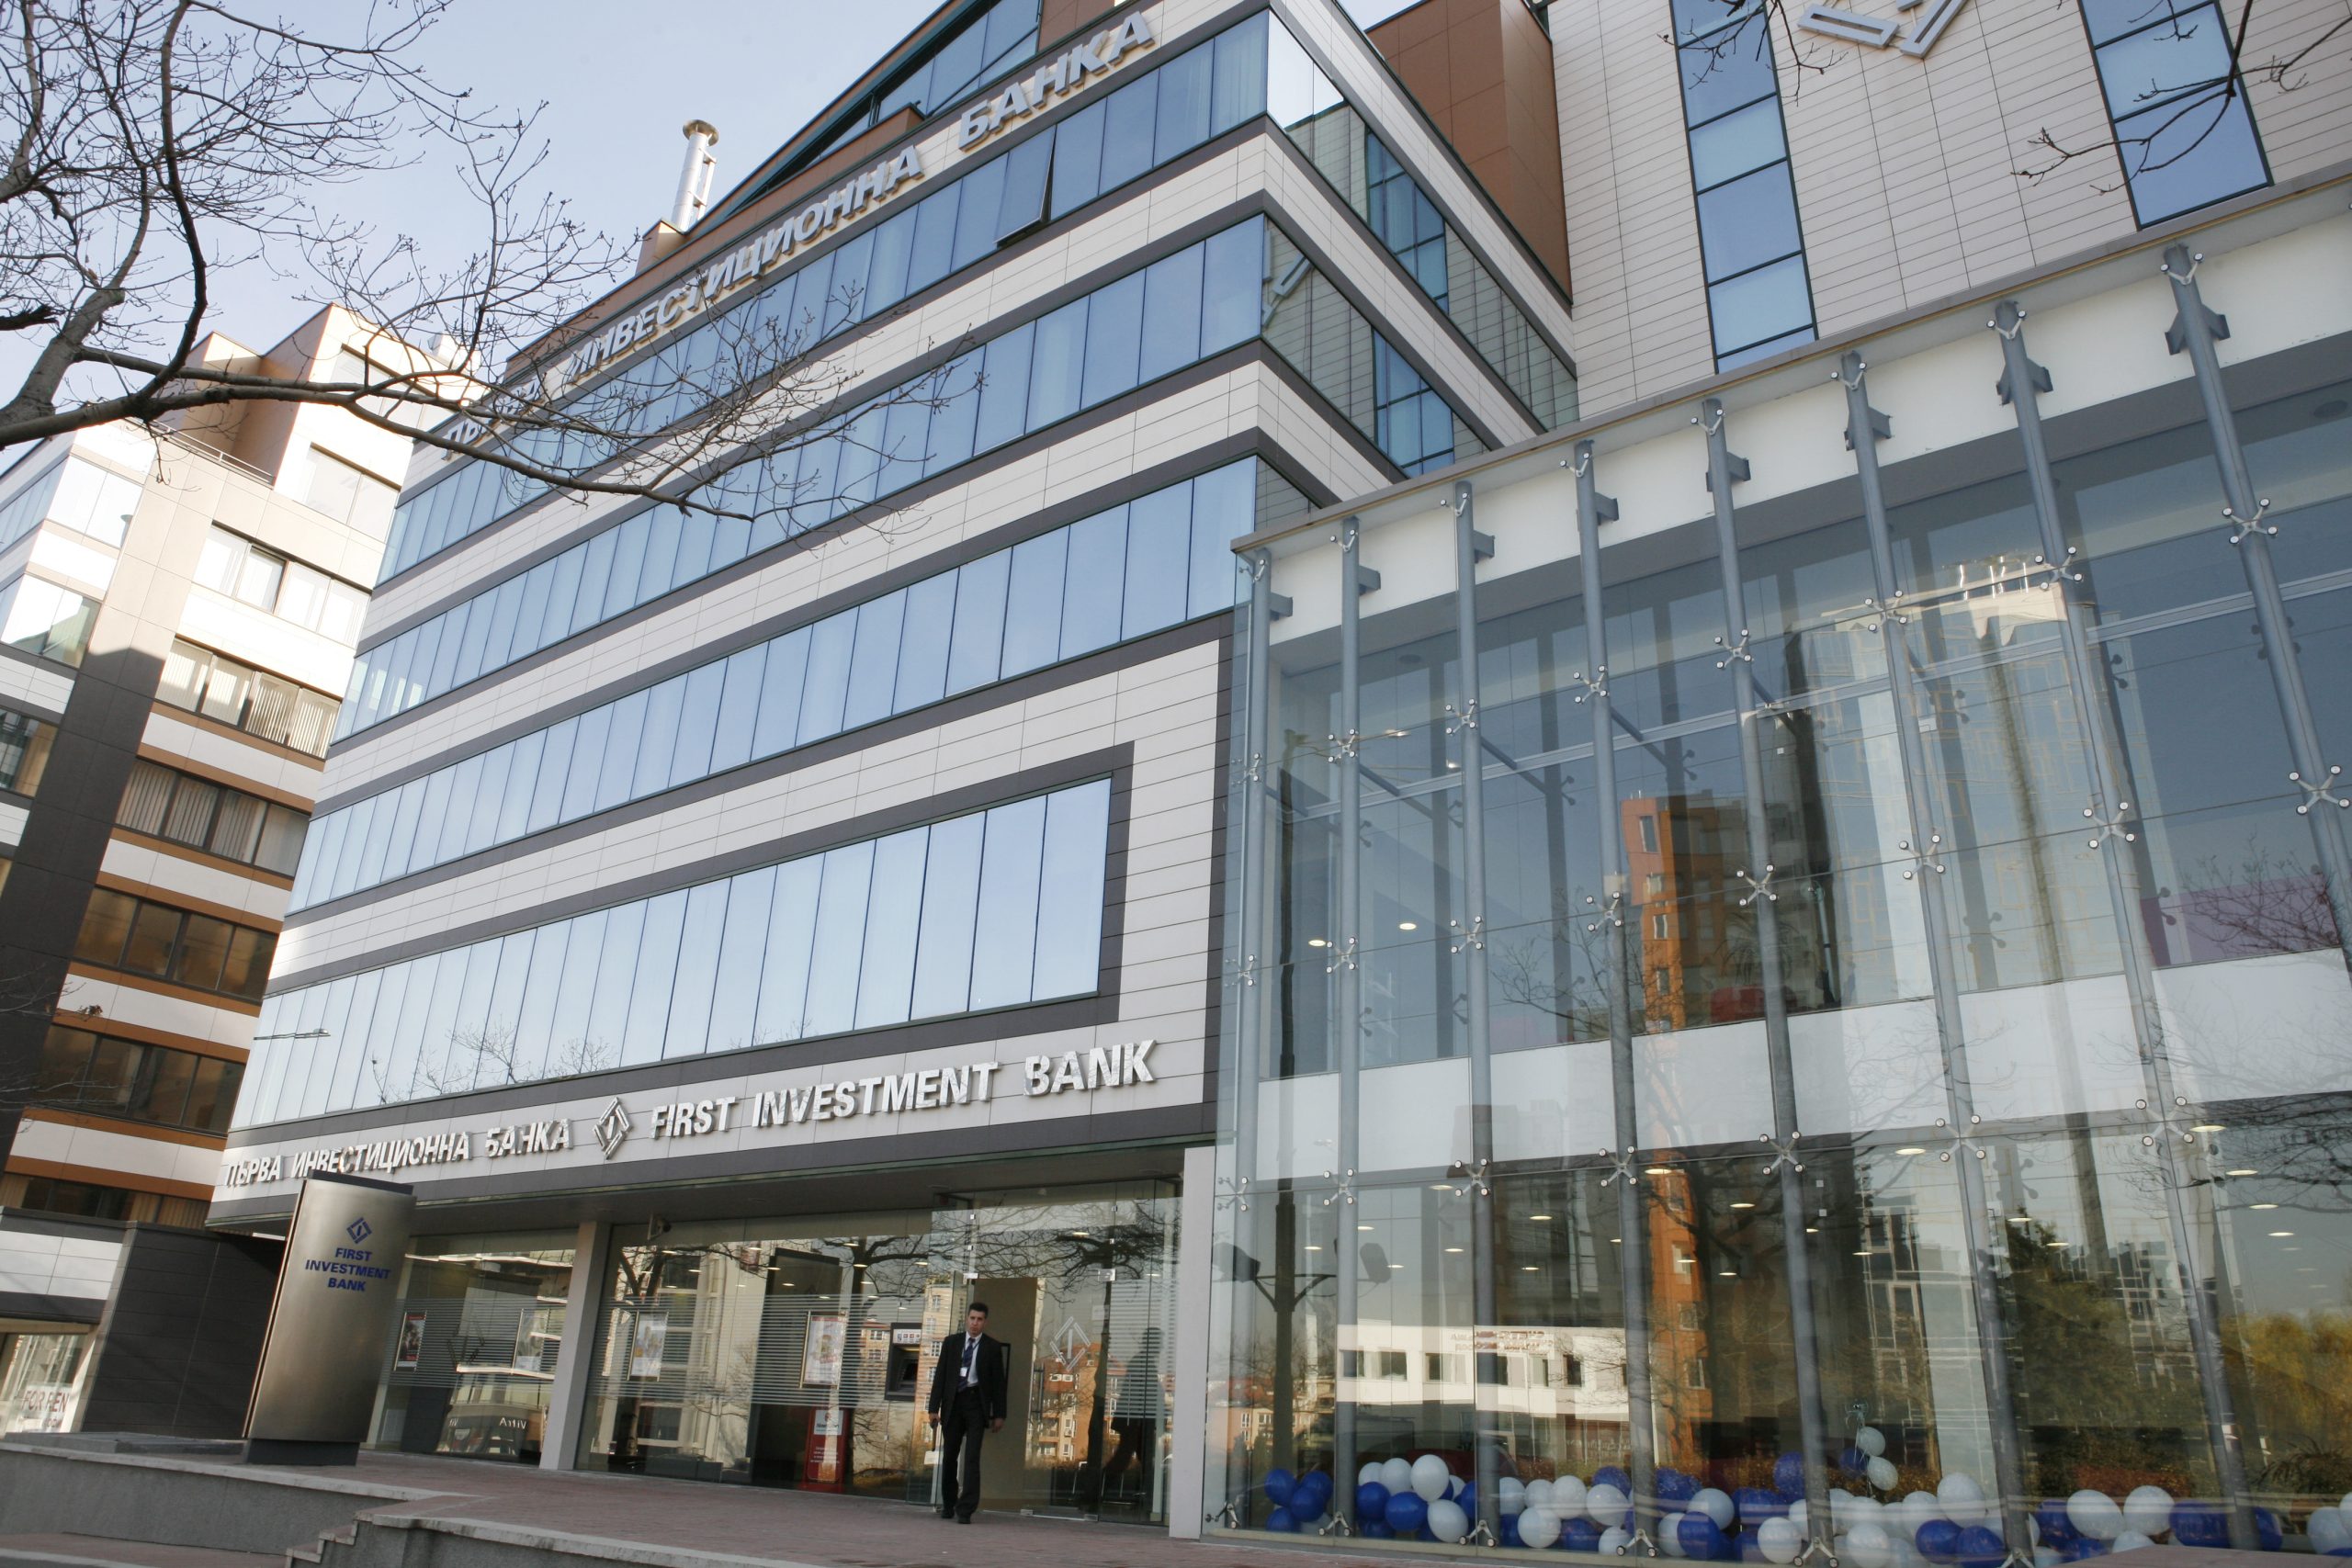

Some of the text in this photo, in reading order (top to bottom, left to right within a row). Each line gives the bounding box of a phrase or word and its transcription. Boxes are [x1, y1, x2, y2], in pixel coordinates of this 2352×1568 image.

[564, 145, 924, 384] ИНВЕСТИЦИОННА
[958, 11, 1155, 152] БАНКА
[650, 1039, 1157, 1140] FIRST INVESTMENT BANK
[224, 1118, 574, 1189] ПЪРВА ИНВЕСТИЦИОННА БАНКА
[334, 1247, 373, 1262] FIRST
[305, 1259, 392, 1280] INVESTMENT
[327, 1278, 367, 1292] BANK
[22, 1390, 71, 1413] FOR REN
